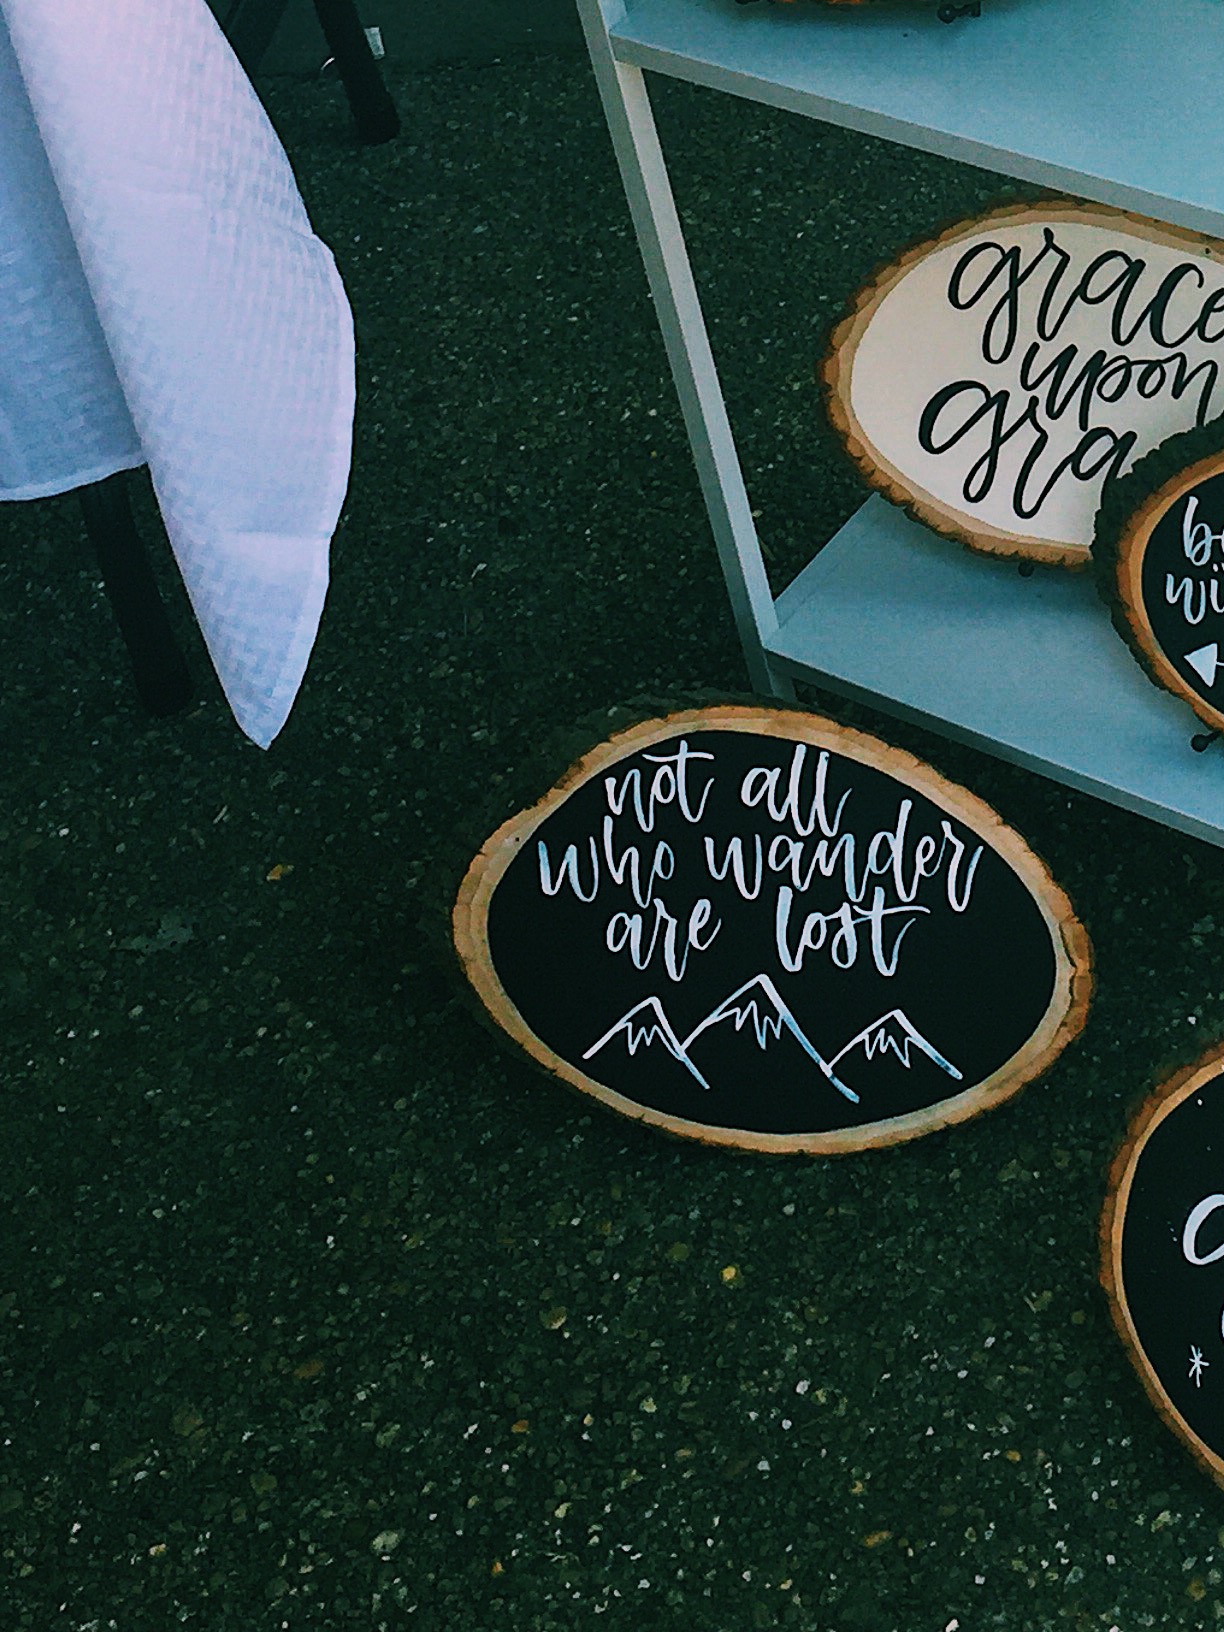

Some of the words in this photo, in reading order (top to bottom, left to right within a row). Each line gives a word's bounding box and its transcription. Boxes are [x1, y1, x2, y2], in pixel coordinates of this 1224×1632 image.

[918, 379, 1138, 519] gra
[604, 740, 715, 833] not
[741, 744, 852, 837] all
[538, 815, 675, 908] who
[703, 799, 984, 912] wander
[606, 898, 722, 982] are
[776, 886, 931, 976] lost
